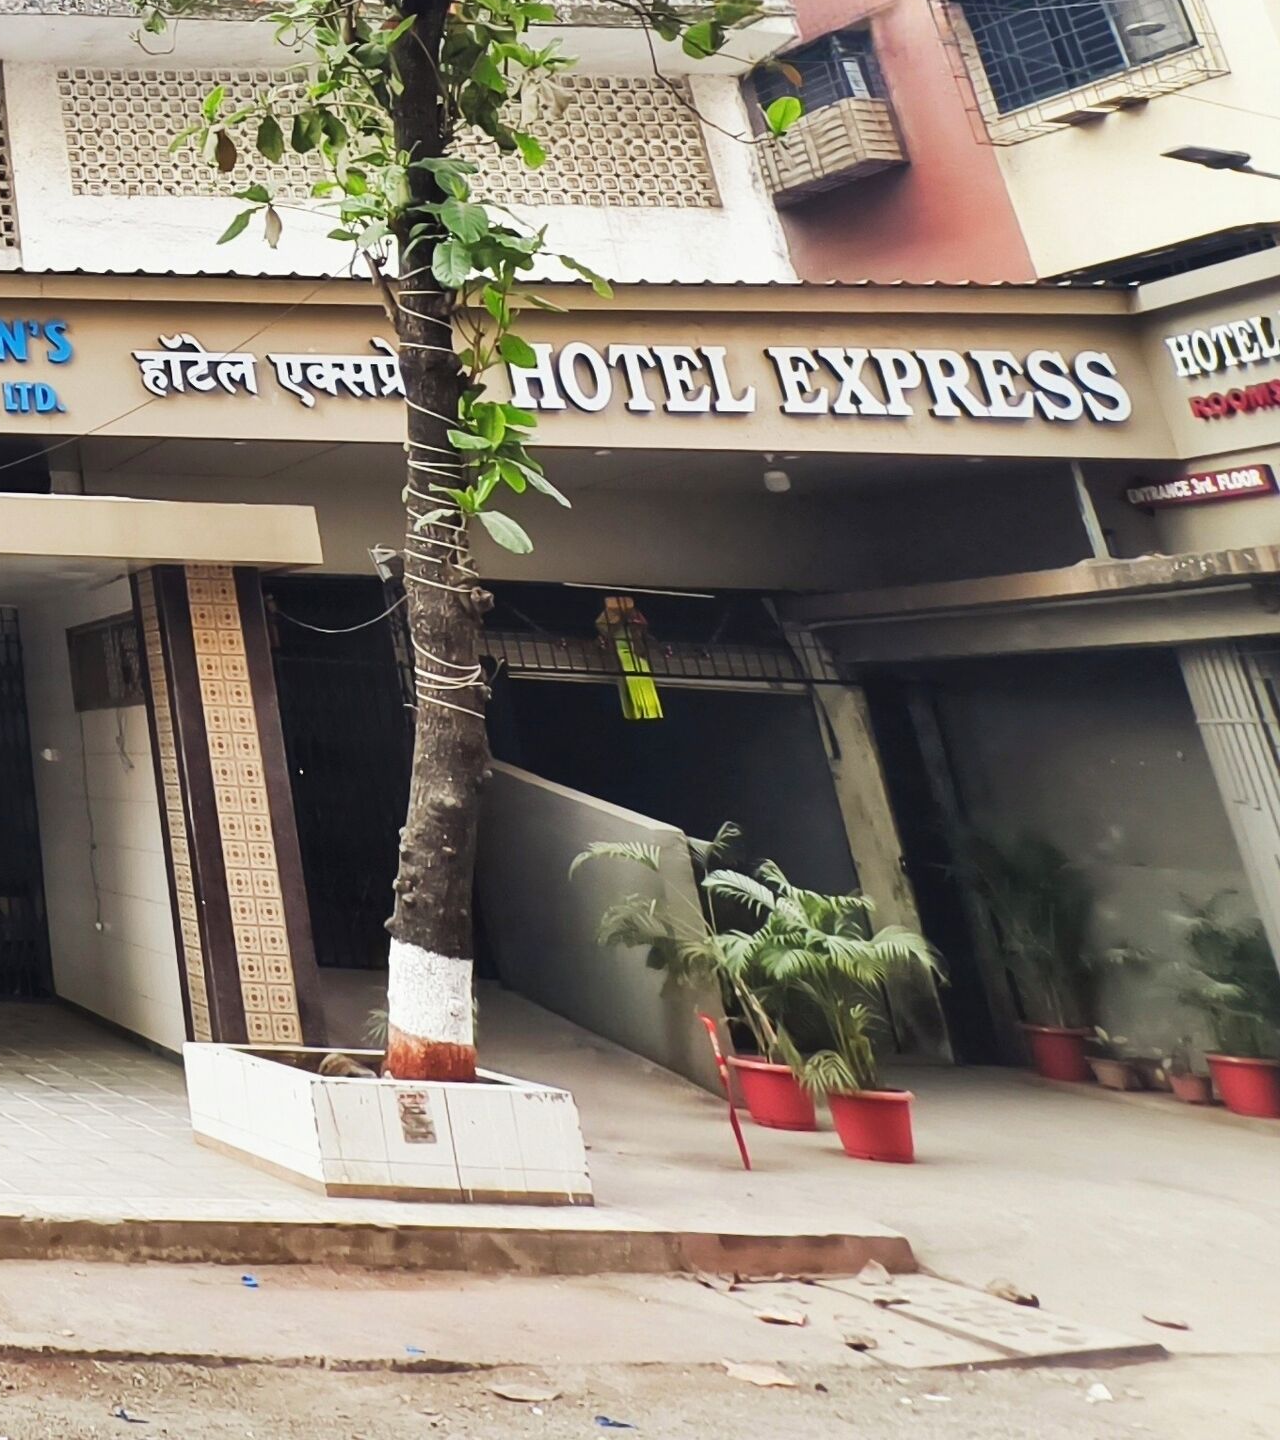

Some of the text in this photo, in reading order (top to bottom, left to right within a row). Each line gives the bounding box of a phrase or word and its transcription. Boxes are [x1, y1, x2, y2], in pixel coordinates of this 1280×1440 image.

[131, 333, 407, 408] हॉटेल एक्सप्रे
[1165, 316, 1280, 377] HOTEL
[2, 381, 66, 414] LTD.
[498, 341, 1132, 426] HOTEL EXPRESS
[1126, 480, 1192, 504] ENTRANCE
[1216, 469, 1263, 491] FLOOR
